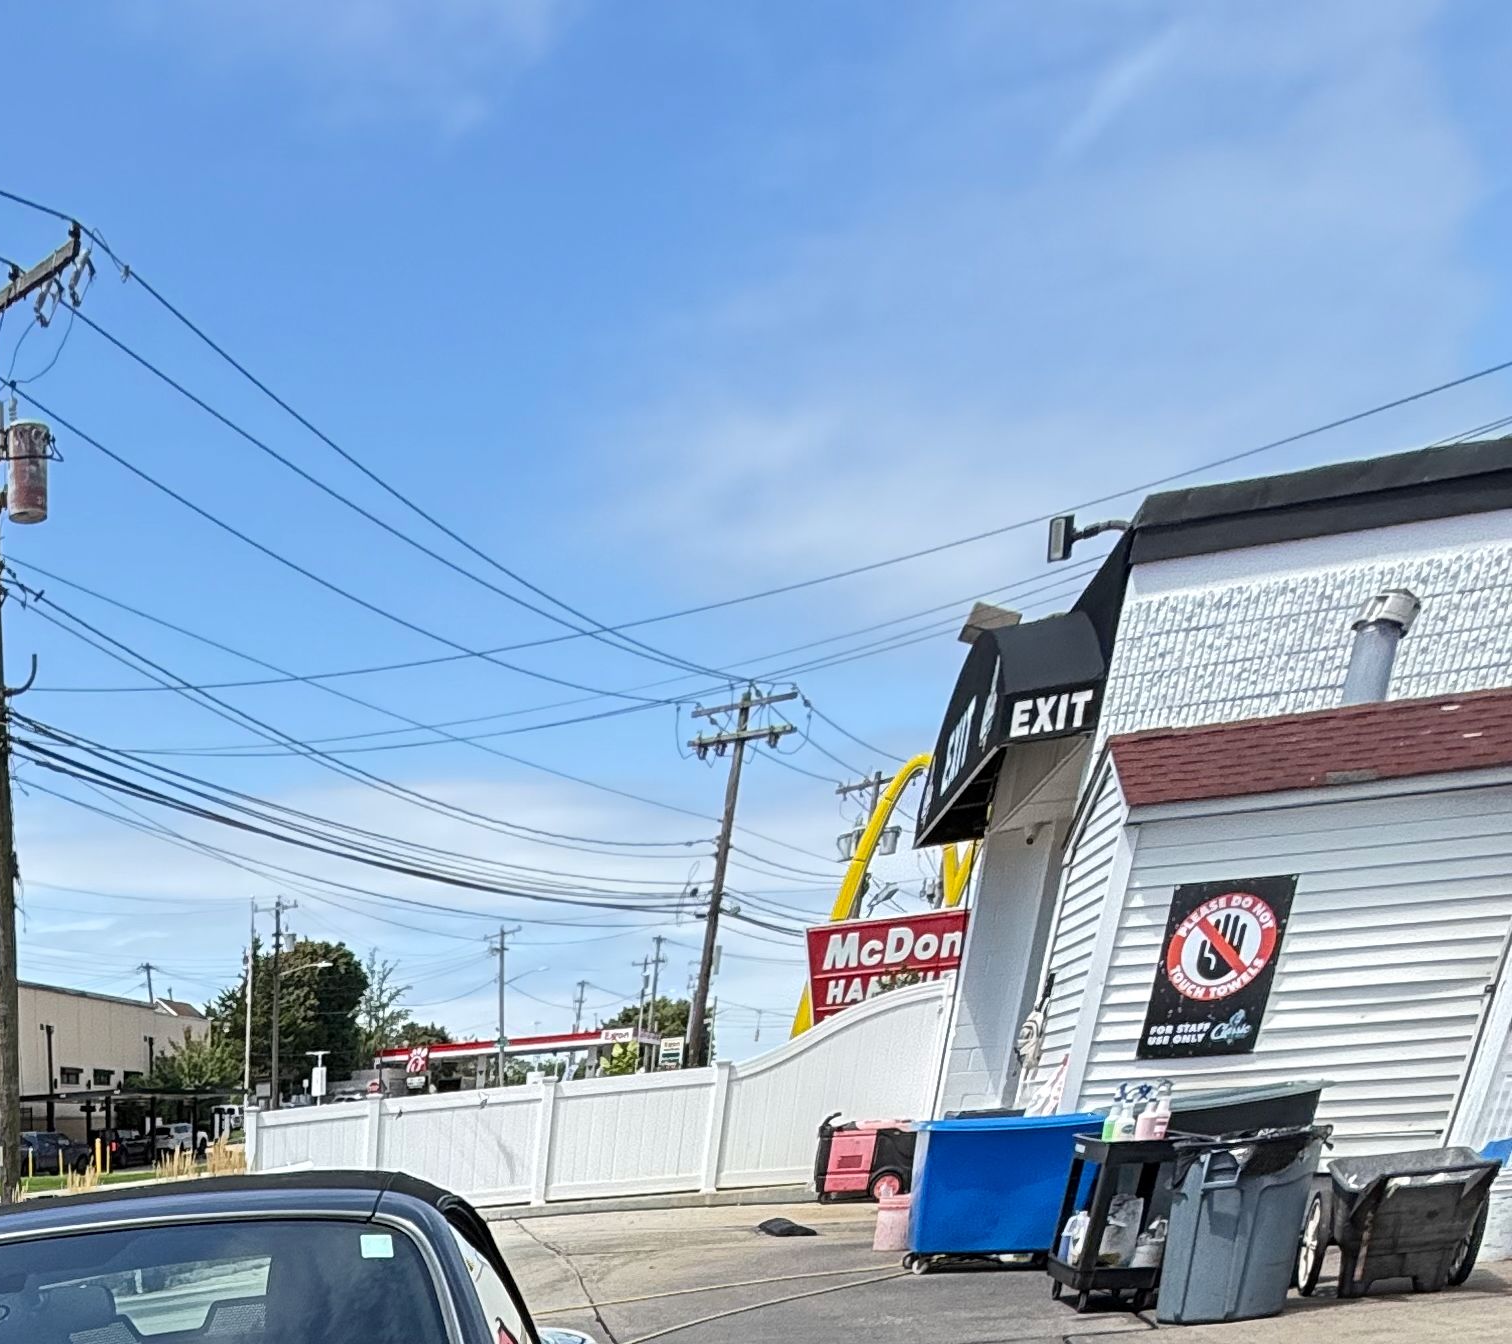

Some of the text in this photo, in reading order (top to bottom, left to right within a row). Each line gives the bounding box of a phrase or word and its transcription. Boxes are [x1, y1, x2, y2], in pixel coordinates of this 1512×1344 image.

[1009, 689, 1094, 738] EXIT
[1176, 895, 1274, 938] PLEASE DO NOT
[1170, 958, 1265, 998] TOUCH TOWELS
[1147, 1033, 1206, 1046] USE ONLY
[1149, 1022, 1211, 1036] FOR STAFF
